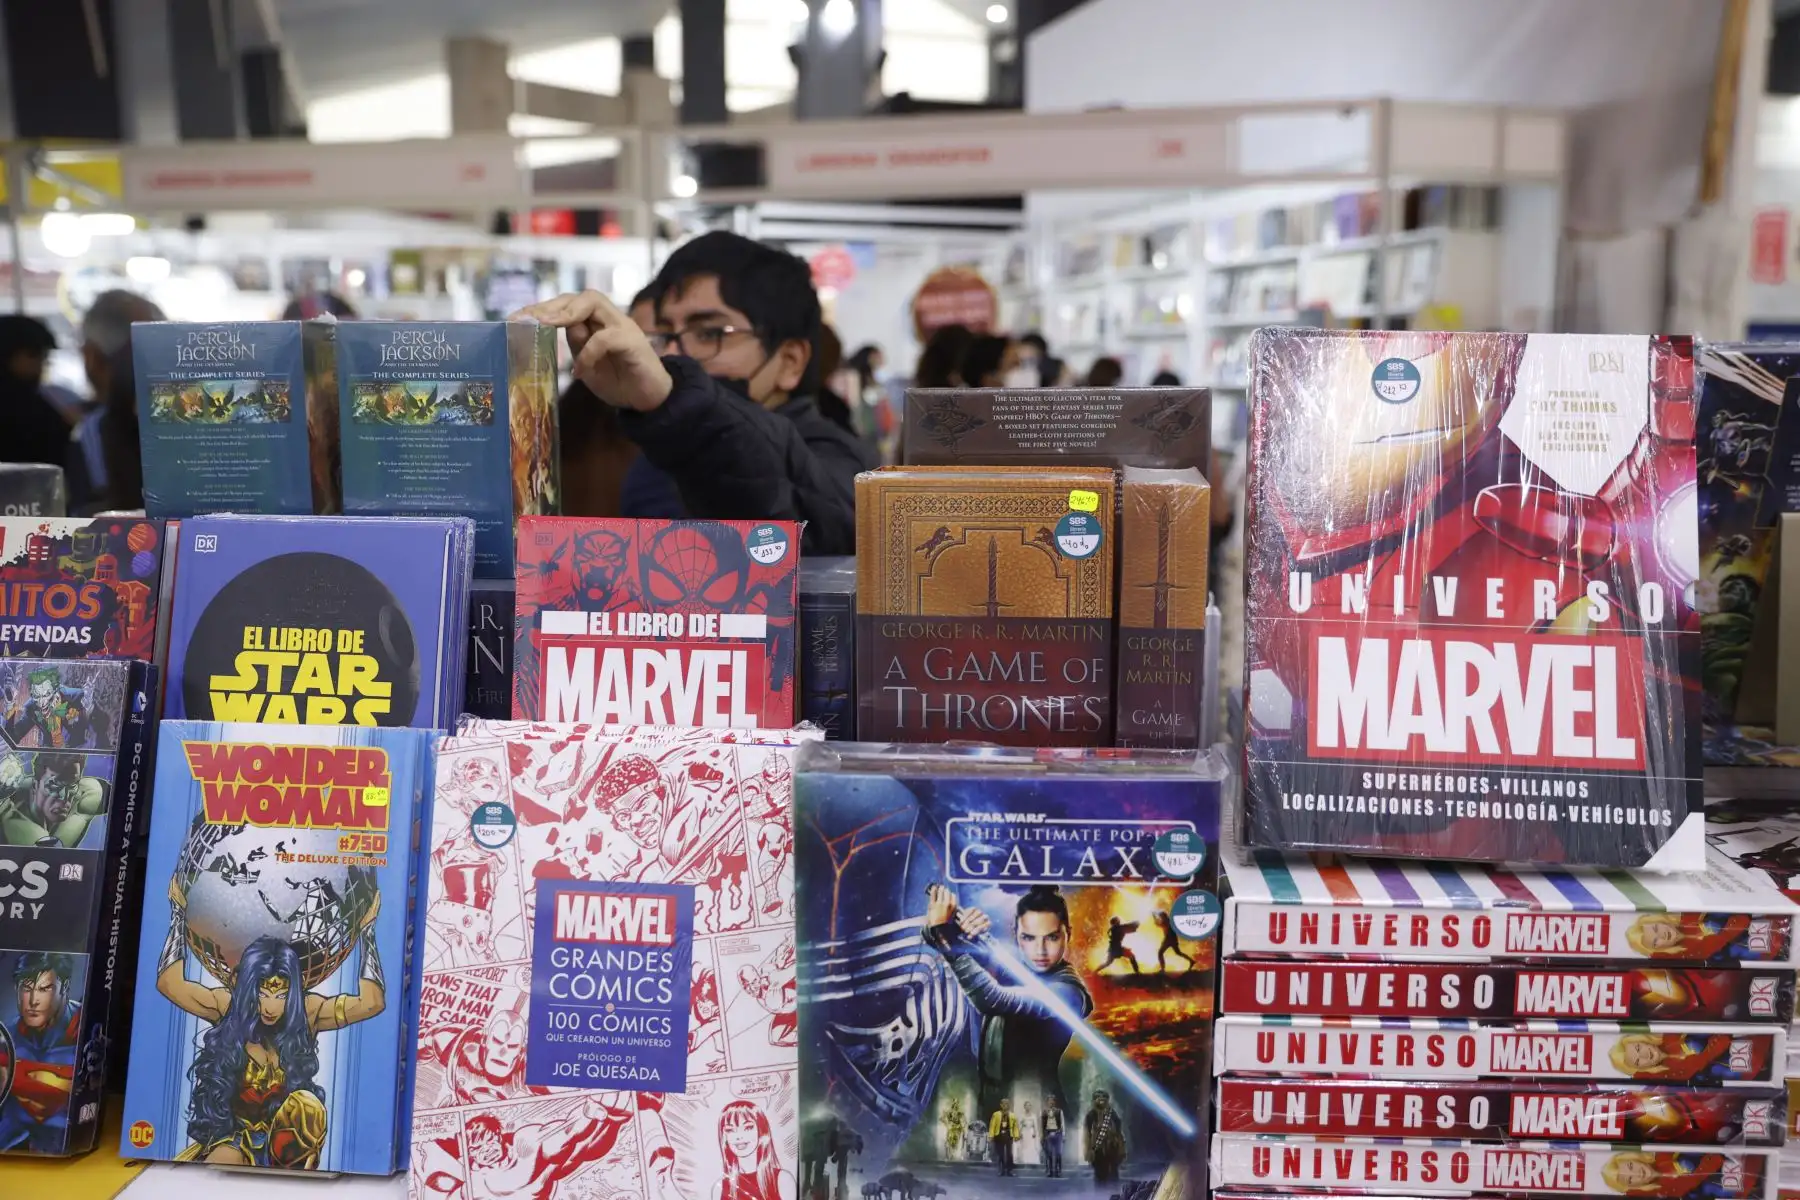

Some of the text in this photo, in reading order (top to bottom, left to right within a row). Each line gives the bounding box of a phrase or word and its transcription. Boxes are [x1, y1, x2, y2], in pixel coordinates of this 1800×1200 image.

[188, 330, 240, 347] PERCY
[392, 329, 445, 346] PERCY
[176, 344, 255, 367] JACKSON
[380, 344, 460, 367] JACKSON
[1387, 363, 1404, 371] SBS
[188, 371, 233, 379] COMPLETE
[439, 371, 470, 379] SERIES
[994, 394, 1007, 402] THE
[5, 502, 42, 516] ONE
[758, 528, 773, 537] SBS
[1069, 517, 1087, 525] SBS
[197, 536, 216, 551] DK
[1288, 572, 1665, 624] UNIVERSO
[590, 612, 718, 638] EL LIBRO DE
[882, 622, 1103, 642] GEORGE R. R. MARTIN
[243, 626, 365, 654] EL LIBRO DE
[1127, 637, 1195, 652] GEORGE
[209, 651, 392, 698] STAR
[884, 647, 1104, 684] A GAME OF
[1126, 669, 1192, 685] MARTIN
[545, 646, 758, 729] MARVEL
[1317, 636, 1636, 760] MARVEL
[209, 692, 391, 727] WARS
[882, 686, 1103, 733] THRONES
[1132, 709, 1185, 726] GAME
[182, 741, 391, 788] WONDER
[1362, 771, 1589, 798] SUPERHÉROES VILLANOS
[203, 782, 389, 831] WOMAN
[485, 806, 503, 815] SBS
[968, 812, 1047, 823] STAR WARS
[1282, 792, 1673, 827] LOCALIZACIONES TECNOLOGÍA VEHÍCULOS
[338, 833, 388, 854] #750
[965, 827, 1101, 842] THE ULTIMATE
[104, 742, 142, 991] DC COMICS A VISUAL HISTORY
[275, 853, 387, 866] THE DELUXE EDITION
[960, 844, 1150, 878] GALAX
[60, 864, 82, 881] DK
[0, 902, 45, 920] RY
[556, 894, 672, 943] MARVEL
[1269, 912, 1771, 952] UNIVERSO MARVEL DK
[551, 947, 673, 973] GRANDES
[464, 981, 503, 1002] THAT
[550, 970, 672, 1004] CÓMICS
[1255, 971, 1778, 1016] UNIVERSO MARVEL DK
[421, 986, 494, 1018] IRON MAN
[548, 1011, 671, 1035] 100 CÓMICS
[546, 1033, 671, 1048] QUE CREARON UN UNIVERSO
[1257, 1032, 1751, 1072] UNIVERSO MARVEL DK
[578, 1052, 637, 1063] PRÓLOGO DE
[553, 1063, 661, 1081] JOE QUESADA
[1253, 1090, 1770, 1137] UNIVERSO MARVEL DK
[130, 1123, 154, 1145] DC
[1252, 1146, 1470, 1183] UNIVERSO
[1484, 1151, 1583, 1188] MARVEL
